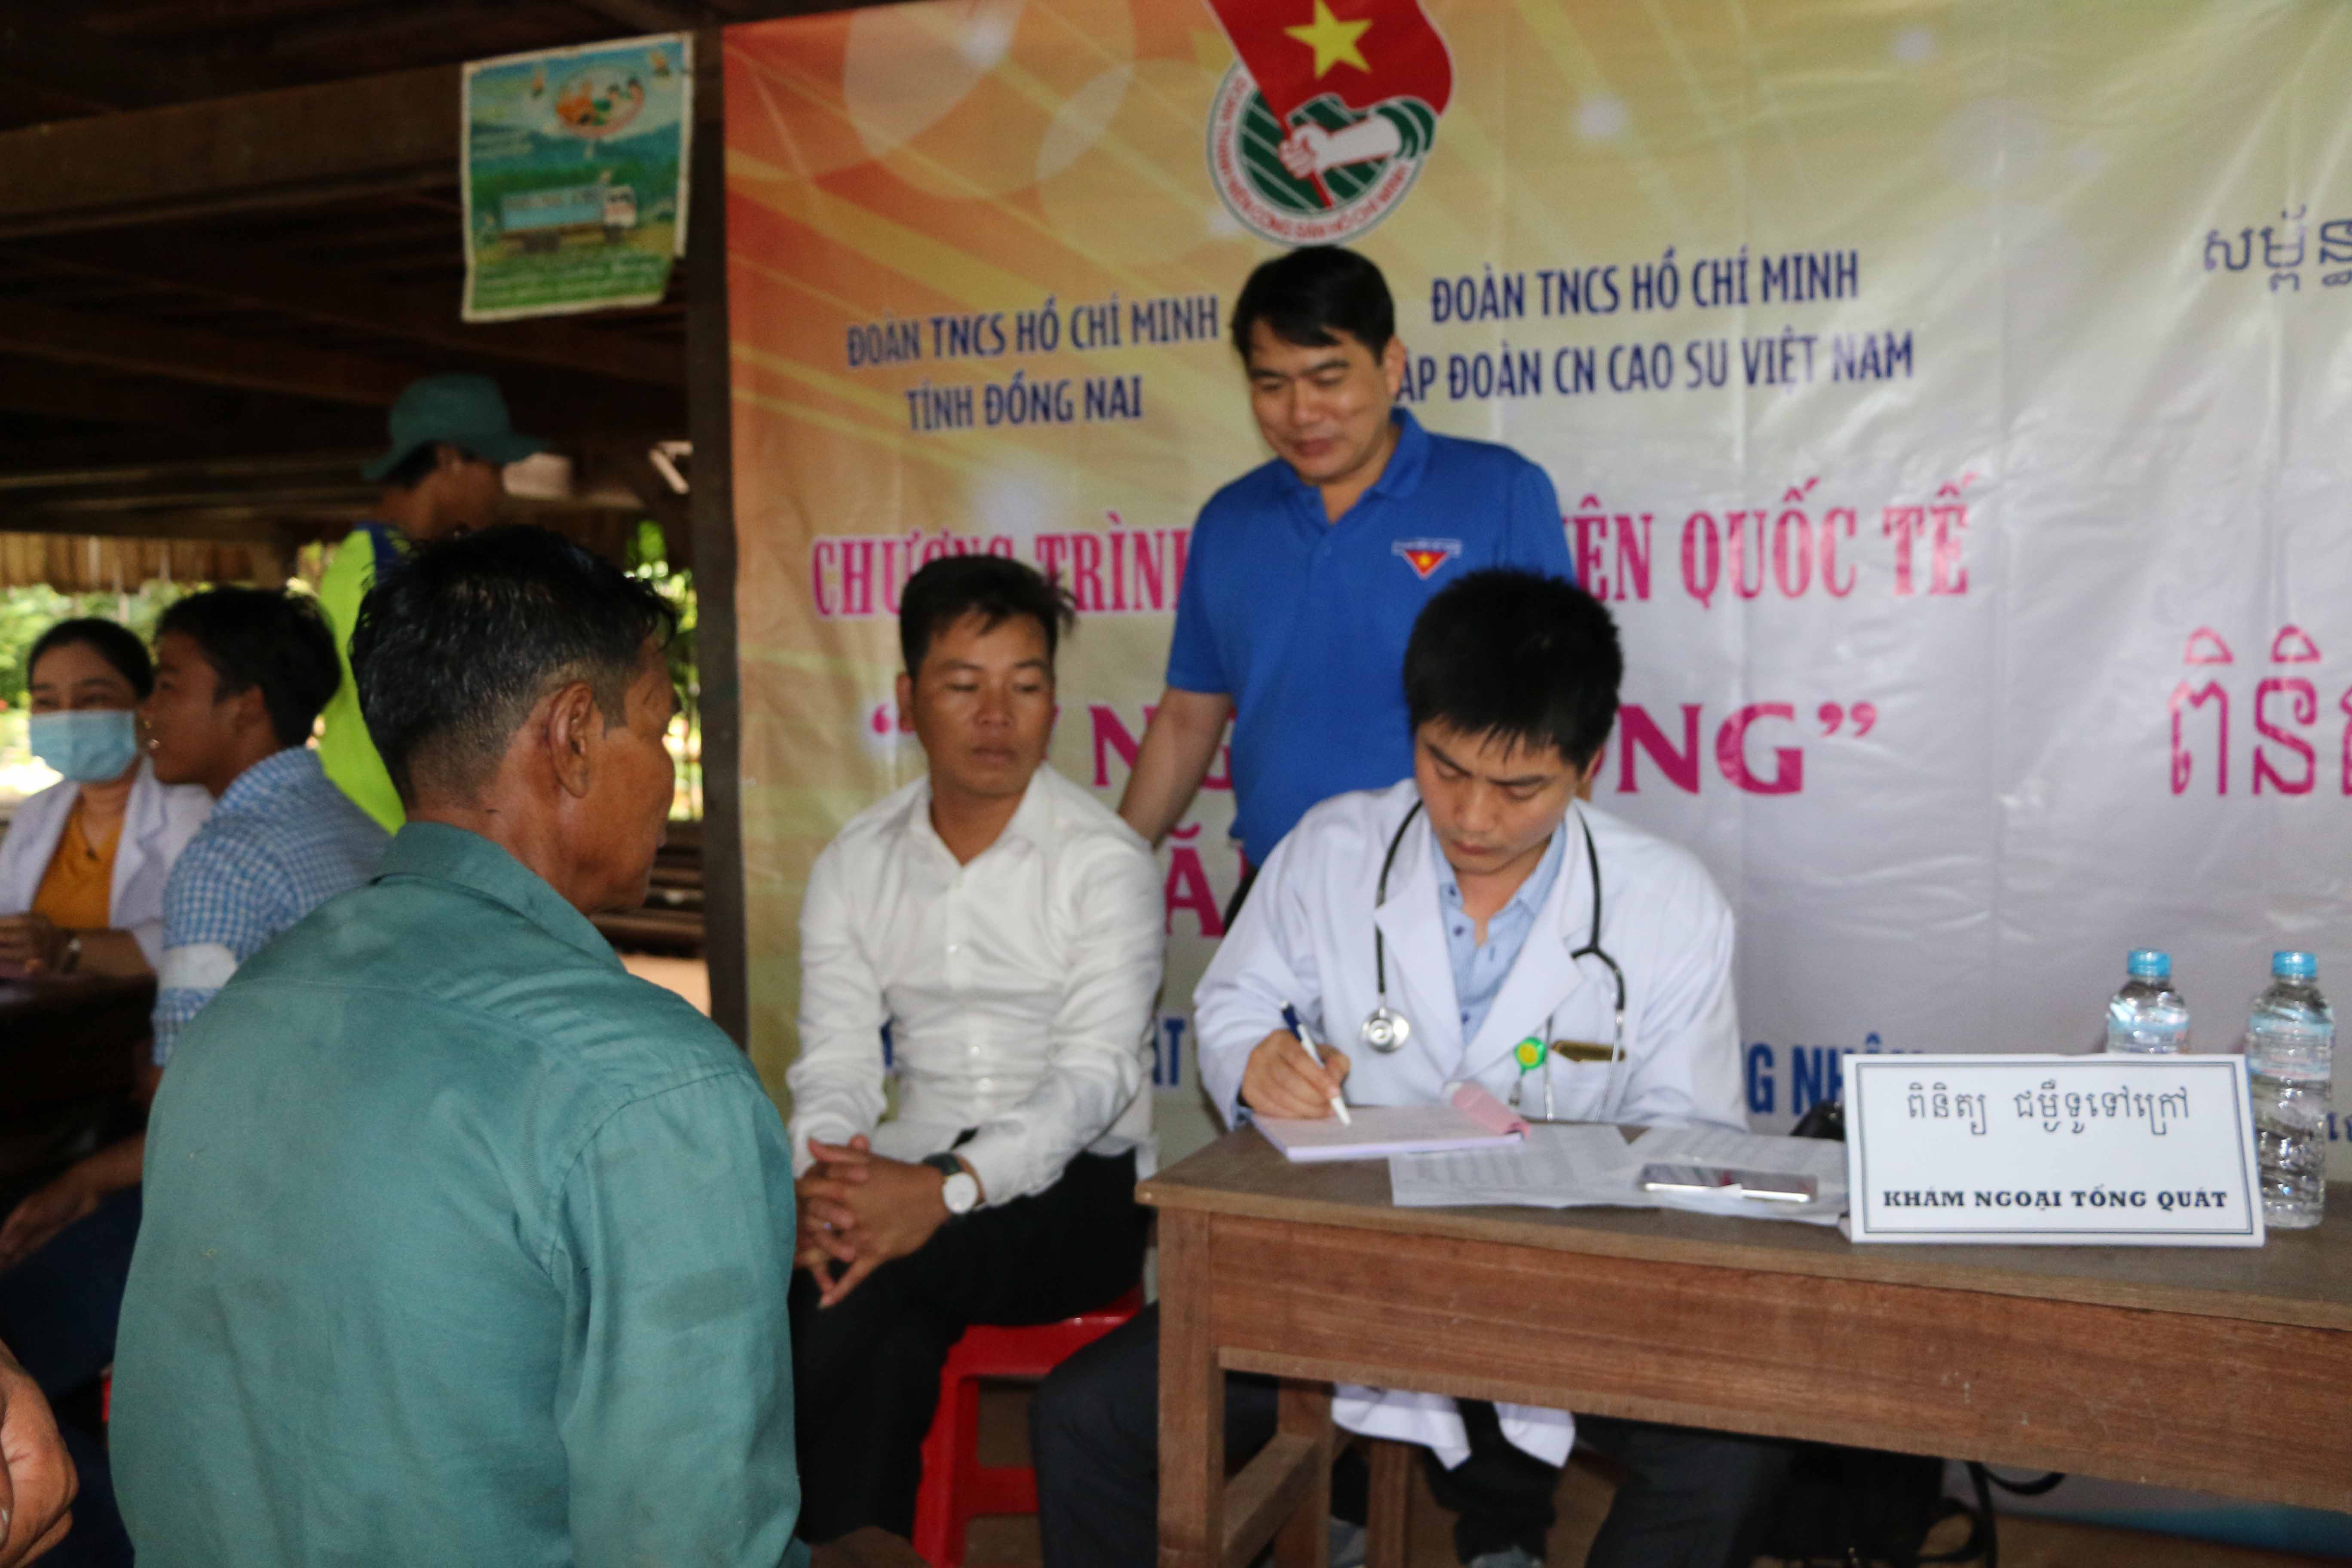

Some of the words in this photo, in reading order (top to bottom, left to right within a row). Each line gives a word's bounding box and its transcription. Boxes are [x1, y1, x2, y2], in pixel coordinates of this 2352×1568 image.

[1431, 263, 1525, 323] ĐOÀN
[1537, 265, 1620, 315] TNCS
[1692, 243, 1749, 306] CHÍ
[1761, 251, 1859, 303] MINH
[847, 309, 921, 367] ĐOÀN
[930, 312, 1006, 358] TNCS
[1070, 292, 1121, 349] CHÍ
[1131, 294, 1219, 343] MINH
[1447, 338, 1542, 401] ĐOÀN
[1553, 350, 1596, 395] CN
[1608, 343, 1673, 393] CAO
[1685, 340, 1729, 389] SU
[1741, 325, 1818, 394] VIỆT
[1831, 329, 1914, 382] NAM
[1084, 375, 1143, 422] NAI
[1680, 477, 1857, 609] QUỐC
[1882, 471, 1979, 597] TẾ
[1883, 1186, 1965, 1207] KHÁM
[1973, 1190, 2063, 1211] NGOẠI
[2157, 1186, 2228, 1212] QUÁT
